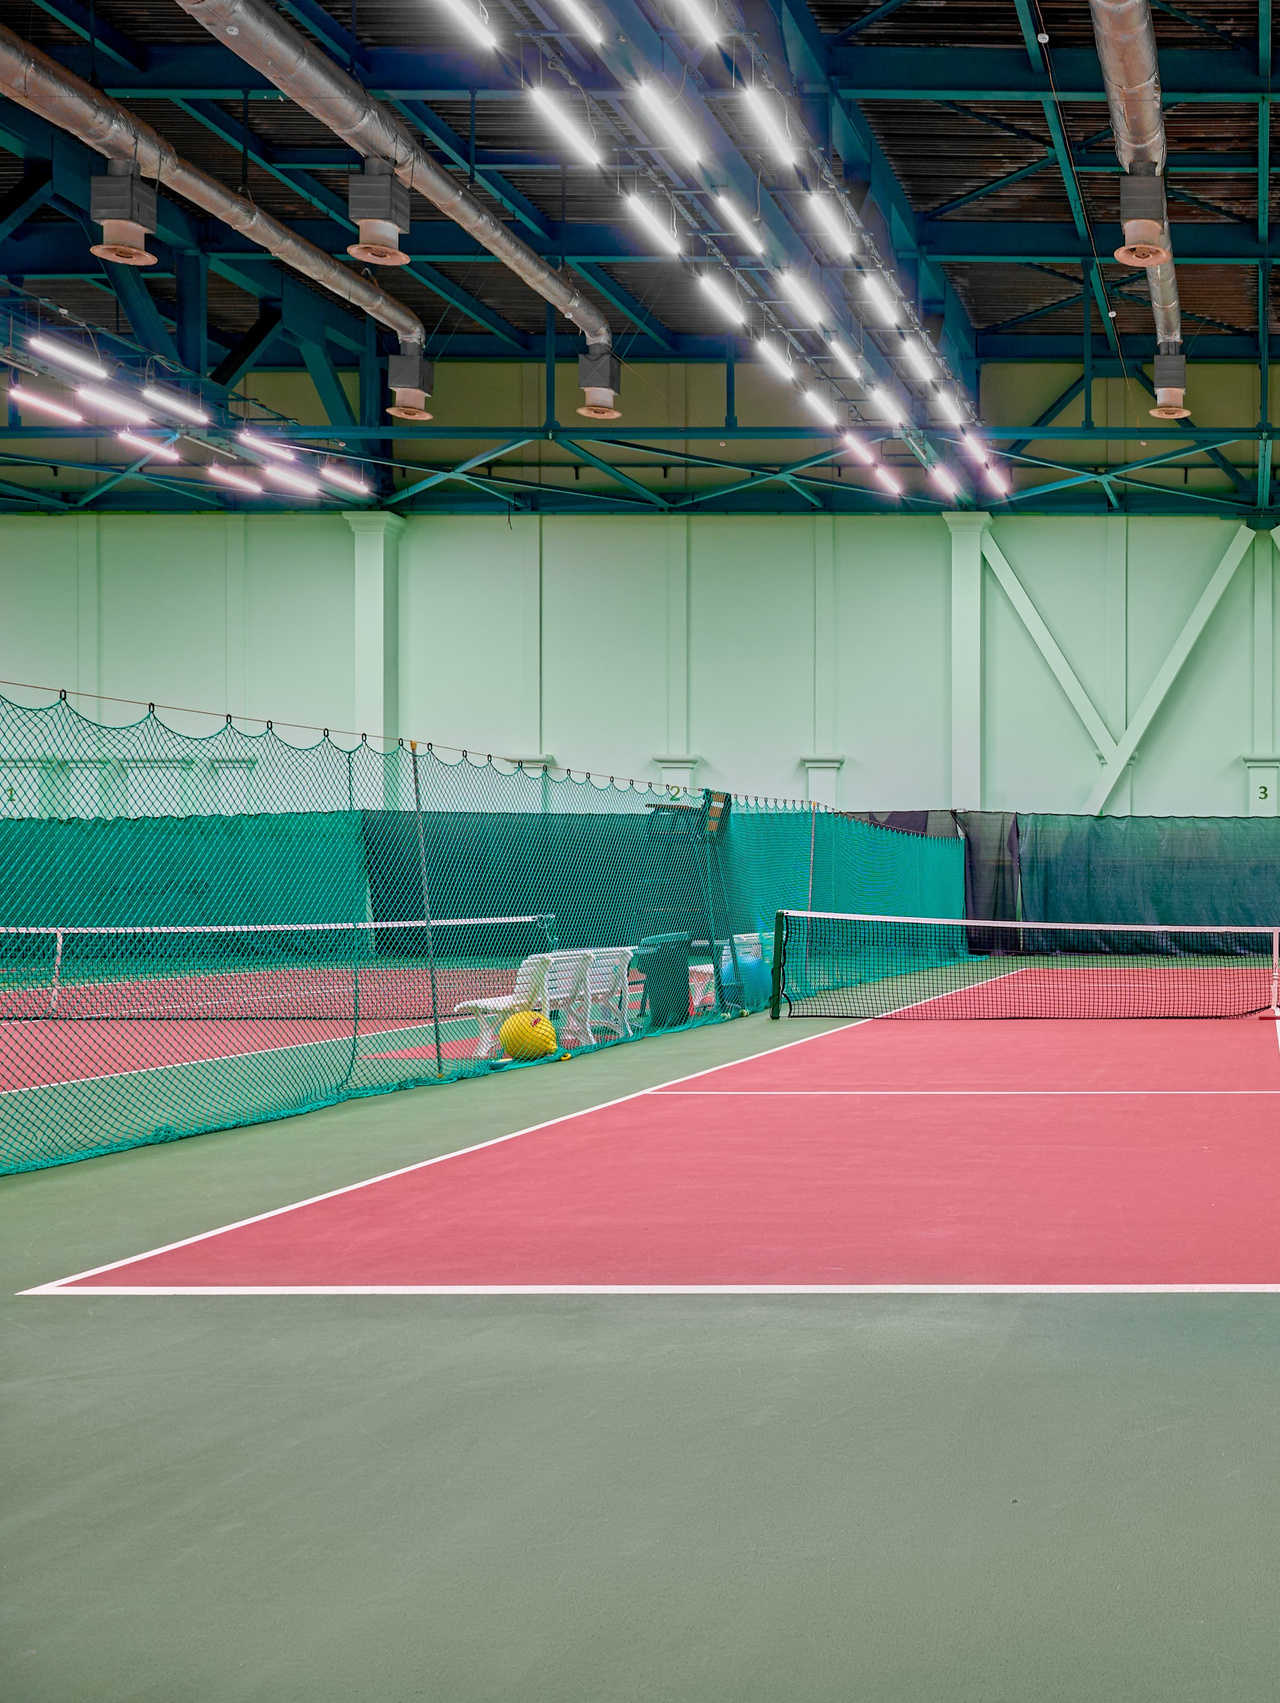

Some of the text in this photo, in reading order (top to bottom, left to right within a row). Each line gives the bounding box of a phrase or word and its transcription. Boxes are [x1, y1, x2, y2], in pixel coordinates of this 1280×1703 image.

[7, 787, 16, 802] 1
[670, 786, 680, 801] 2
[1258, 785, 1269, 800] 3
